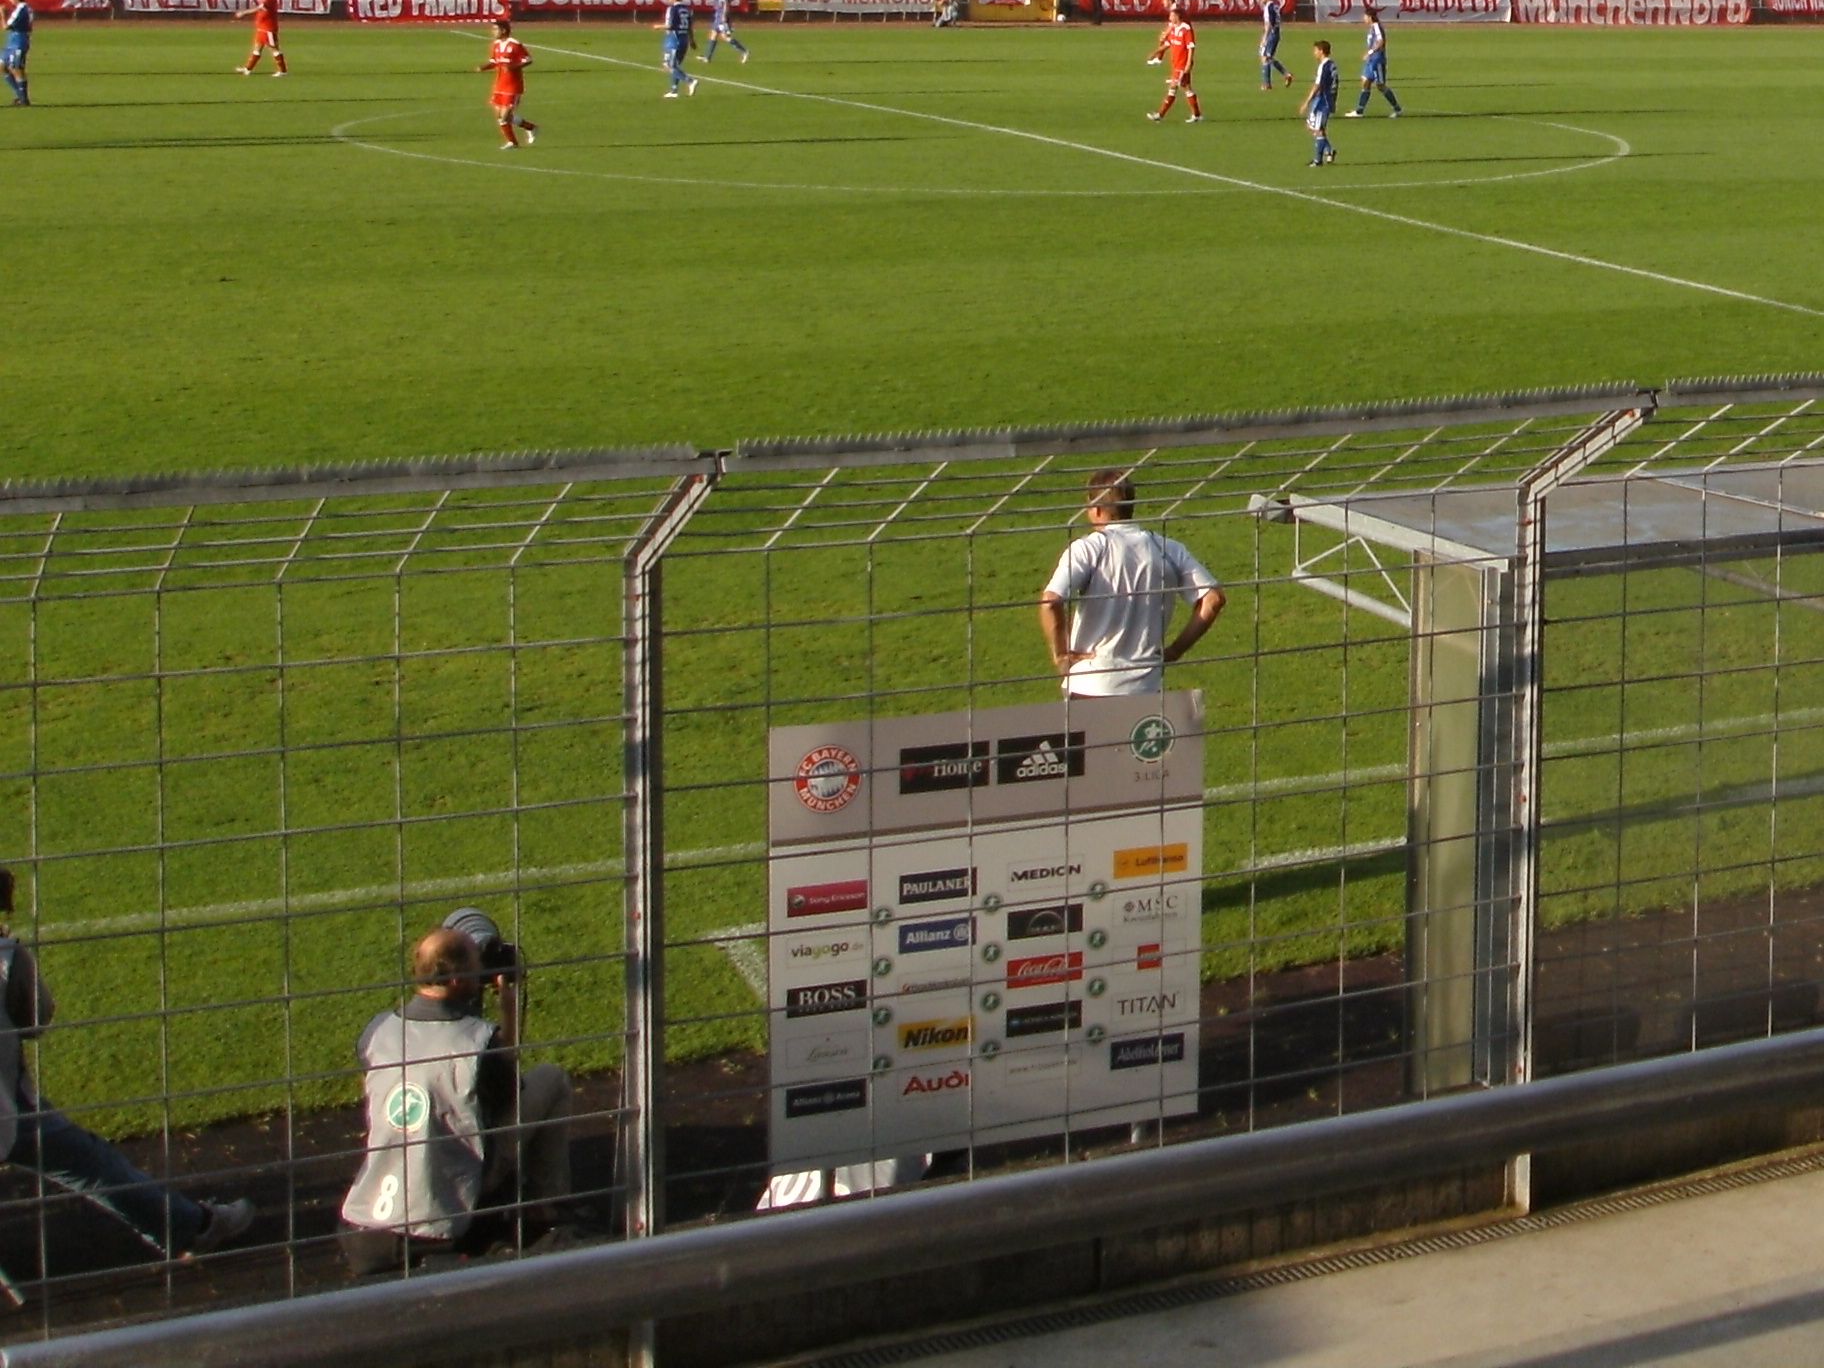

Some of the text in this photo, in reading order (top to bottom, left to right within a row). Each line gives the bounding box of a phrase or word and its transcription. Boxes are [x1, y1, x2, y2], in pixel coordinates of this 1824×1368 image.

[812, 748, 858, 772] BAYERN
[1016, 762, 1067, 778] adidas
[1011, 864, 1081, 882] MEDION
[903, 877, 971, 896] PAULANER
[906, 930, 951, 945] Allianz
[799, 985, 856, 1006] BOSS
[1117, 993, 1177, 1016] TITAN
[904, 1025, 969, 1049] Nikon
[903, 1070, 969, 1096] Audi
[373, 1174, 399, 1220] 8
